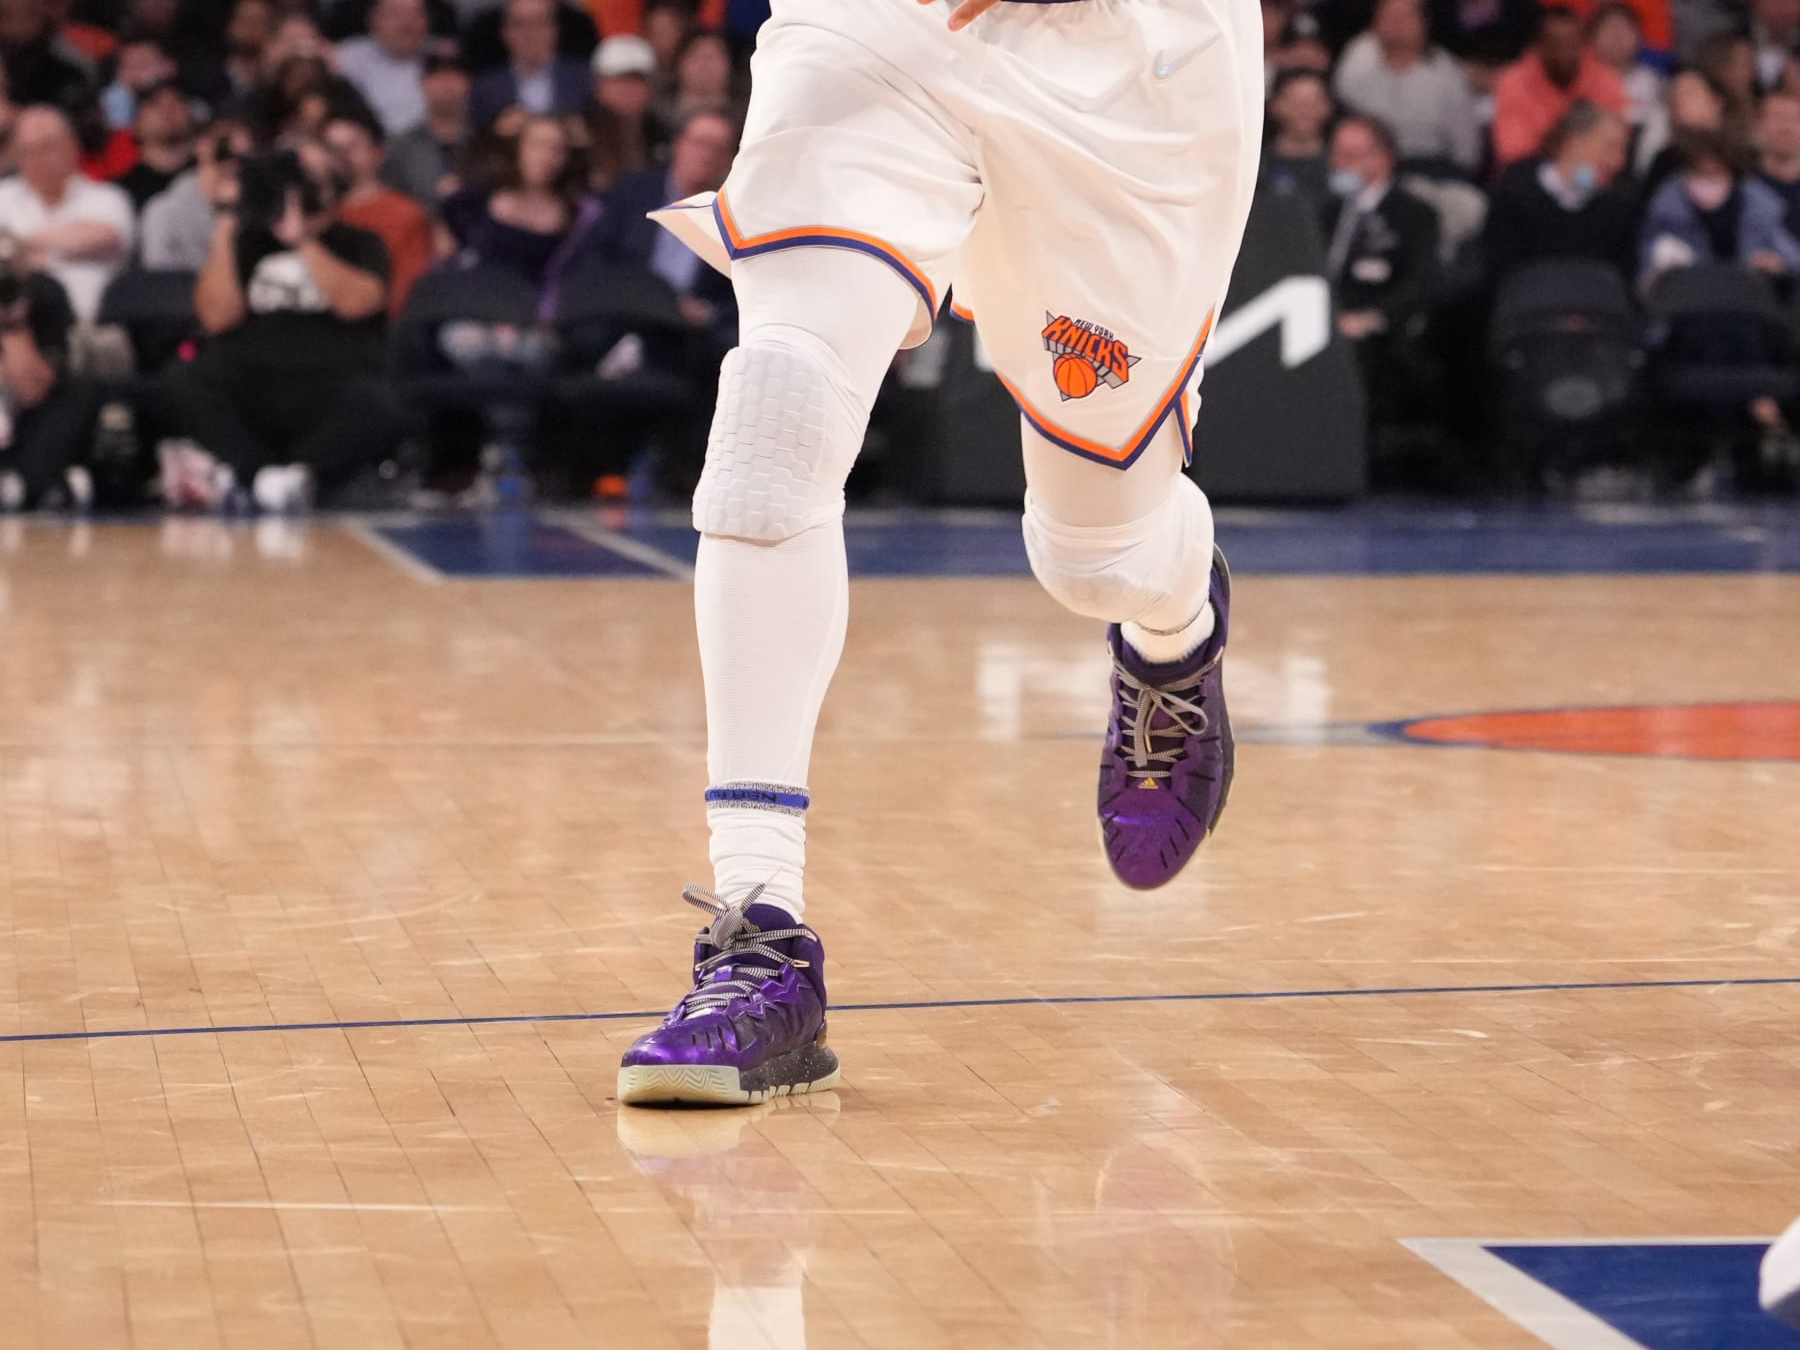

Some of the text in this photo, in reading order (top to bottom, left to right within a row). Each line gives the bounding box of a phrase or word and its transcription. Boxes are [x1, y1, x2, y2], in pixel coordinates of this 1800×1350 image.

[1041, 315, 1129, 383] KNICKS
[1074, 319, 1114, 341] NEW YORK
